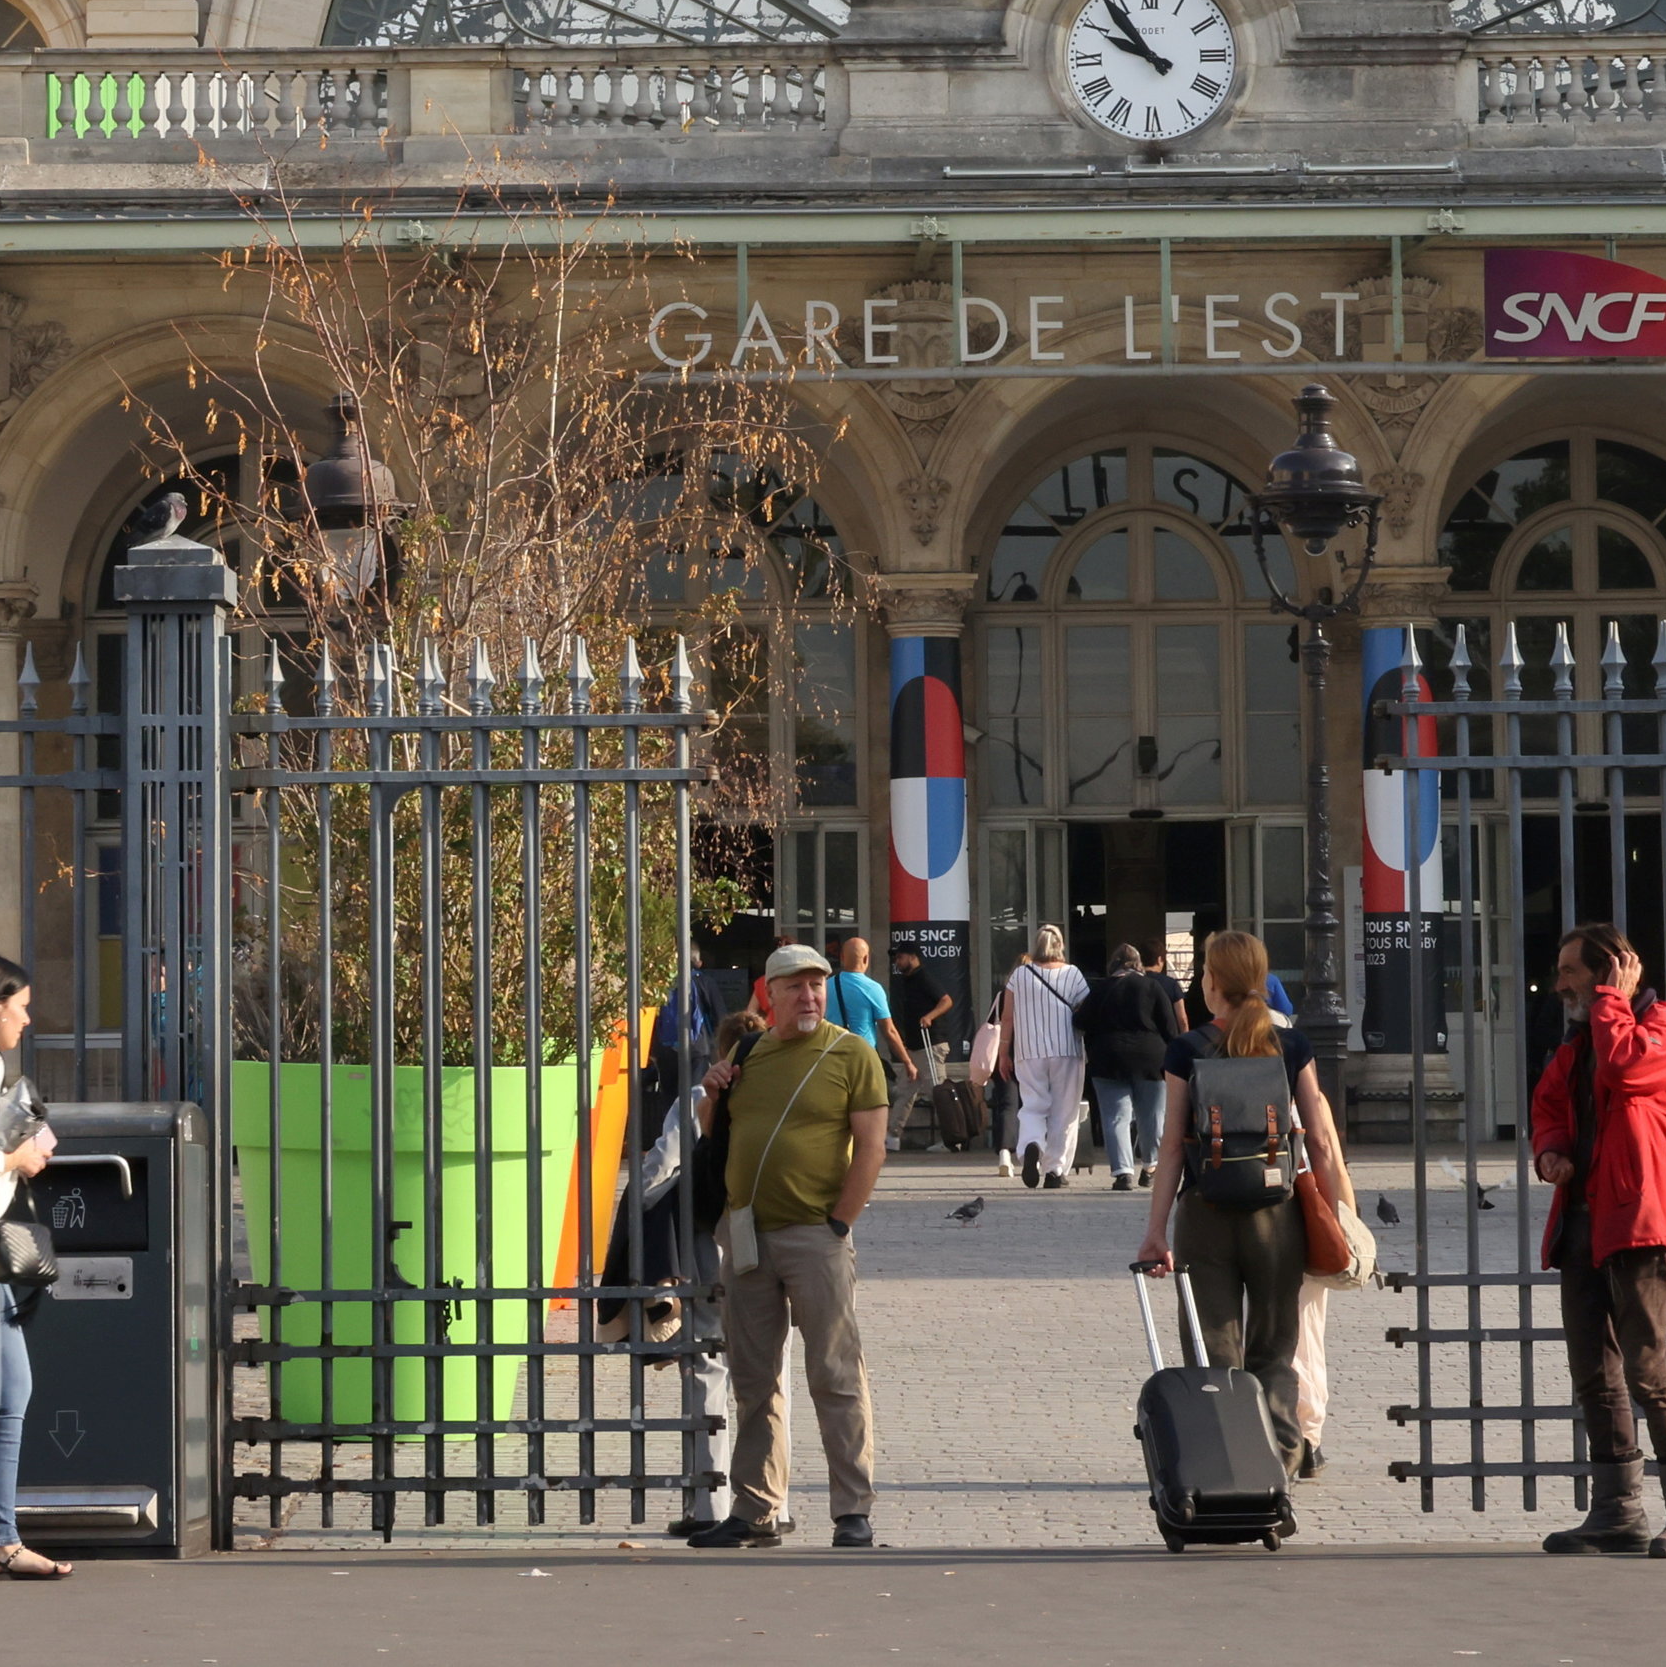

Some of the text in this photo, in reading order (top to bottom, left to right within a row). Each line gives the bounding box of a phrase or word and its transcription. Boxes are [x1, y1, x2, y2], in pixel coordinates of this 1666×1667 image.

[1190, 16, 1217, 35] II
[1076, 51, 1102, 67] IX
[1200, 49, 1226, 62] III
[1082, 76, 1114, 107] VIII
[1107, 97, 1133, 127] VII
[1145, 106, 1162, 132] VI
[1177, 99, 1196, 124] V
[648, 292, 1359, 368] GARE DE L'EST
[920, 930, 955, 941] SNCF
[1365, 921, 1392, 933] TOUS
[1366, 937, 1437, 949] TOUS RUBY
